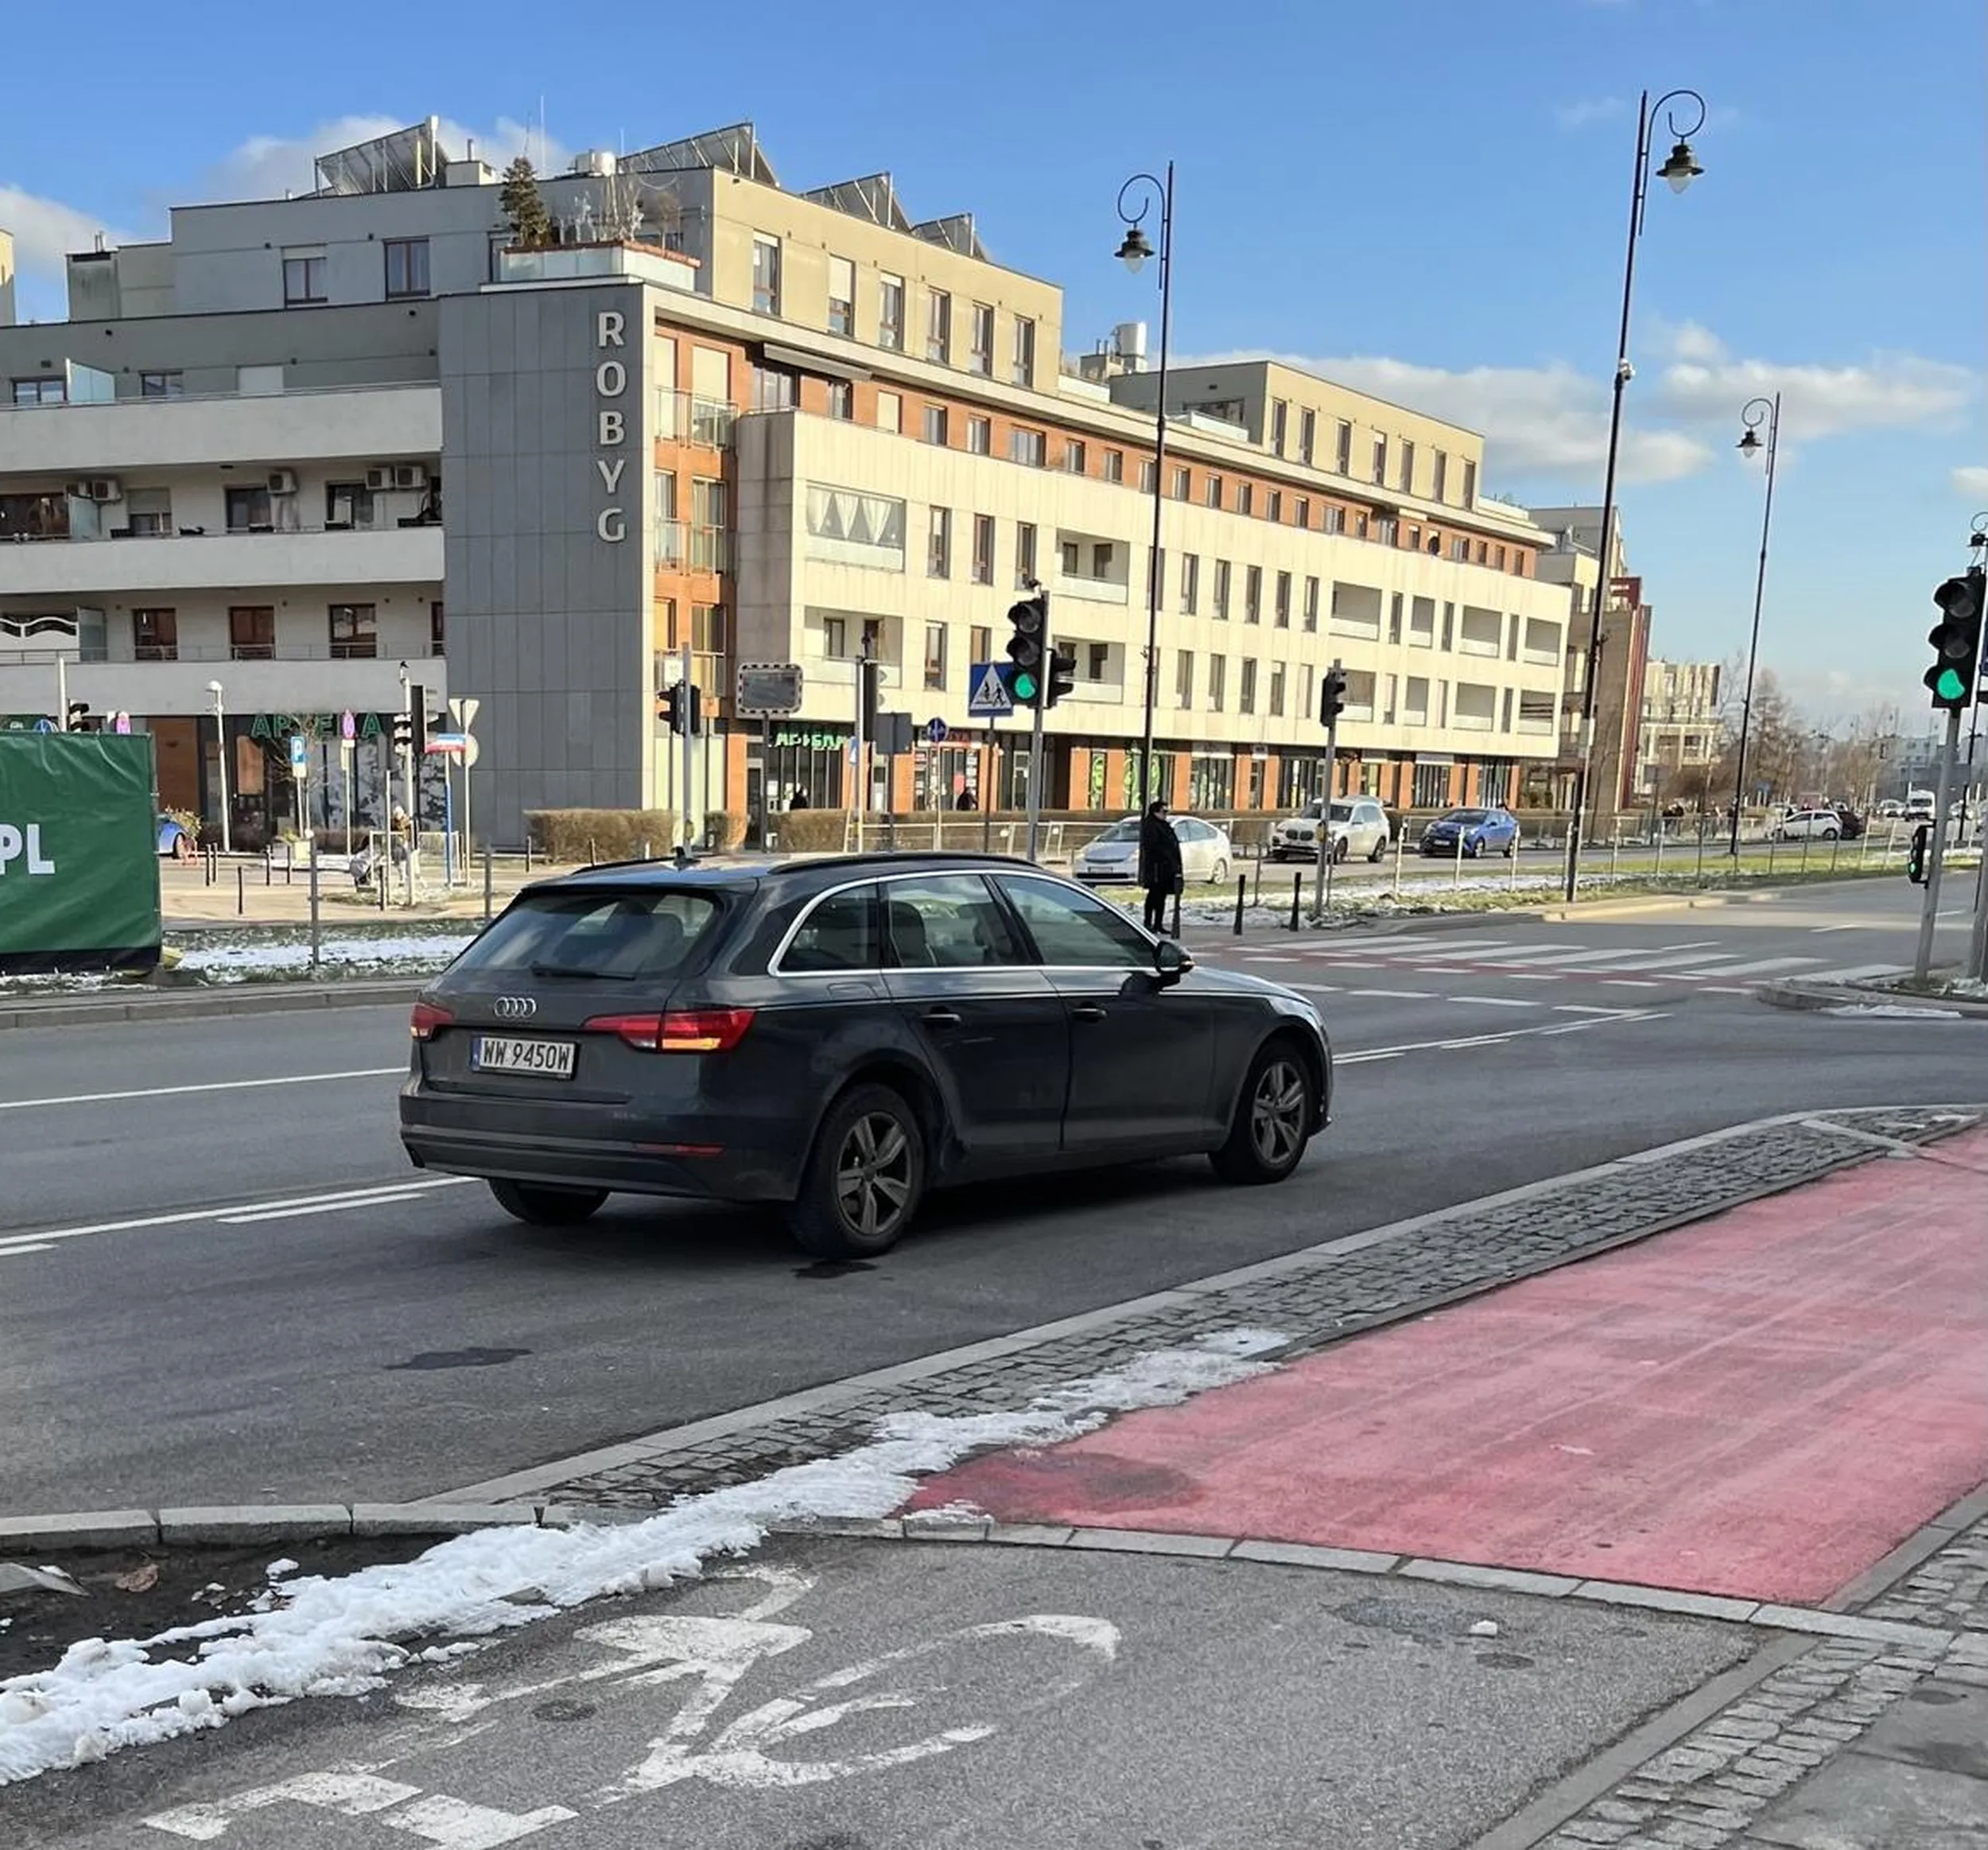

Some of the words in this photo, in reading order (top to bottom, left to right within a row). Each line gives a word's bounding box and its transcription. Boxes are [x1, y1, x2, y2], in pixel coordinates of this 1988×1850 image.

[596, 312, 627, 542] ROBYG
[250, 713, 382, 739] APEA
[0, 823, 56, 875] PL
[483, 1040, 507, 1065] WW
[511, 1043, 570, 1071] 9450W
